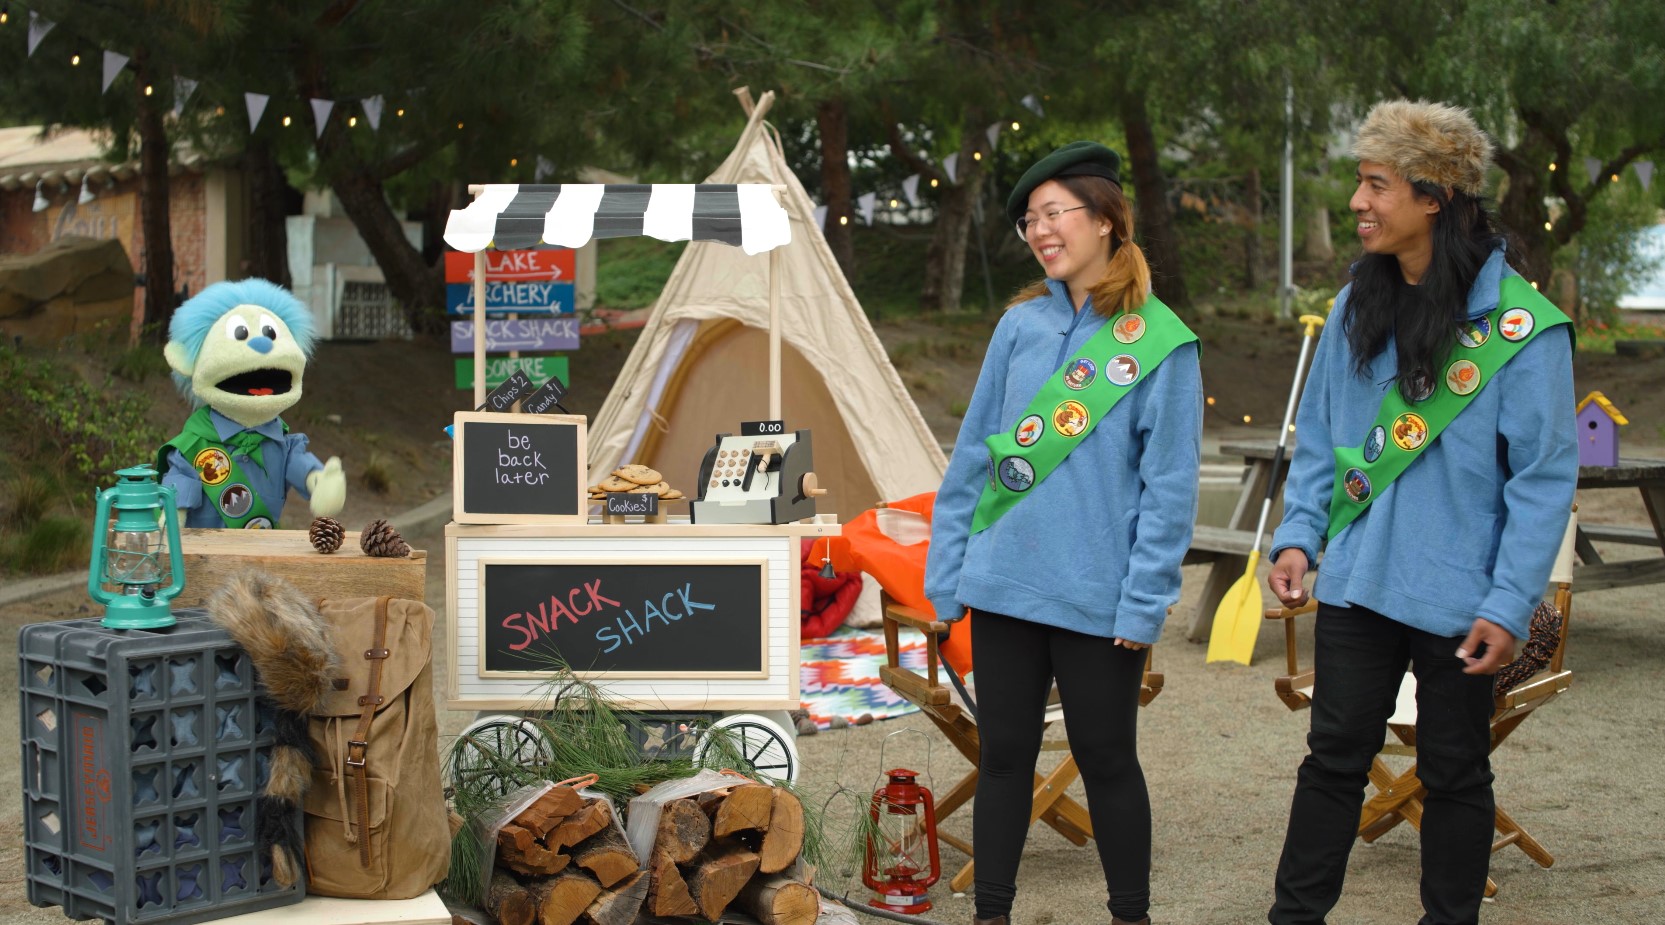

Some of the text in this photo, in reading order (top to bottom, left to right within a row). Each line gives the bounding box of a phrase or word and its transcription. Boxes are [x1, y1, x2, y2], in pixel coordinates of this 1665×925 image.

[484, 251, 541, 272] LAKE
[518, 319, 578, 339] SHACK
[492, 375, 528, 409] Chips $2
[527, 382, 562, 414] Candy $1
[759, 422, 782, 433] 0.00
[508, 429, 531, 450] be
[498, 448, 547, 469] back
[495, 467, 550, 485] later
[608, 493, 653, 513] Cookies $1
[501, 578, 621, 651] SNACK
[595, 582, 716, 654] SHACK
